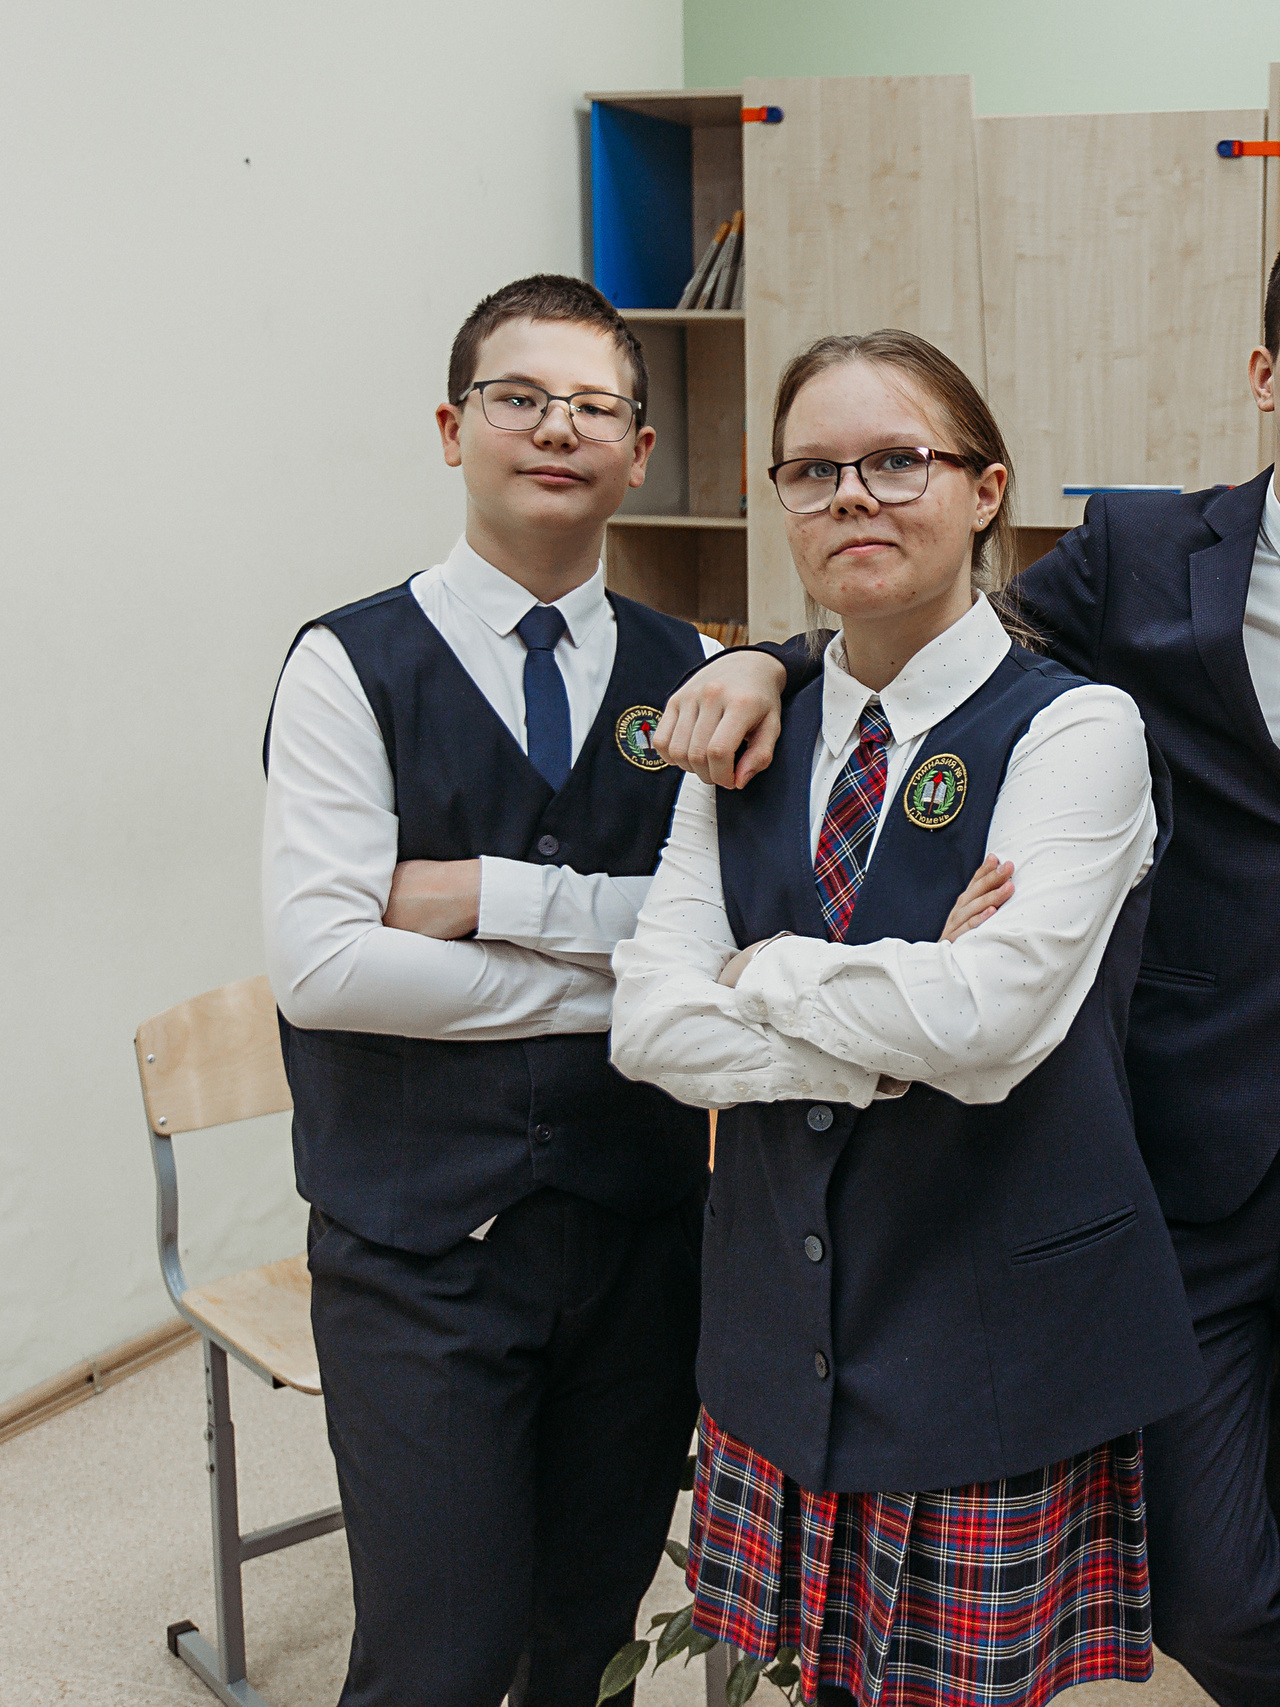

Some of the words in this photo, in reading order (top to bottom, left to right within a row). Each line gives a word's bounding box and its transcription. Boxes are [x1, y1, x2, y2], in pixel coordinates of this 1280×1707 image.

[619, 709, 653, 738] ГИМНАЗИЯ
[912, 758, 957, 785] ГИМНАЗИЯ
[954, 767, 963, 779] №
